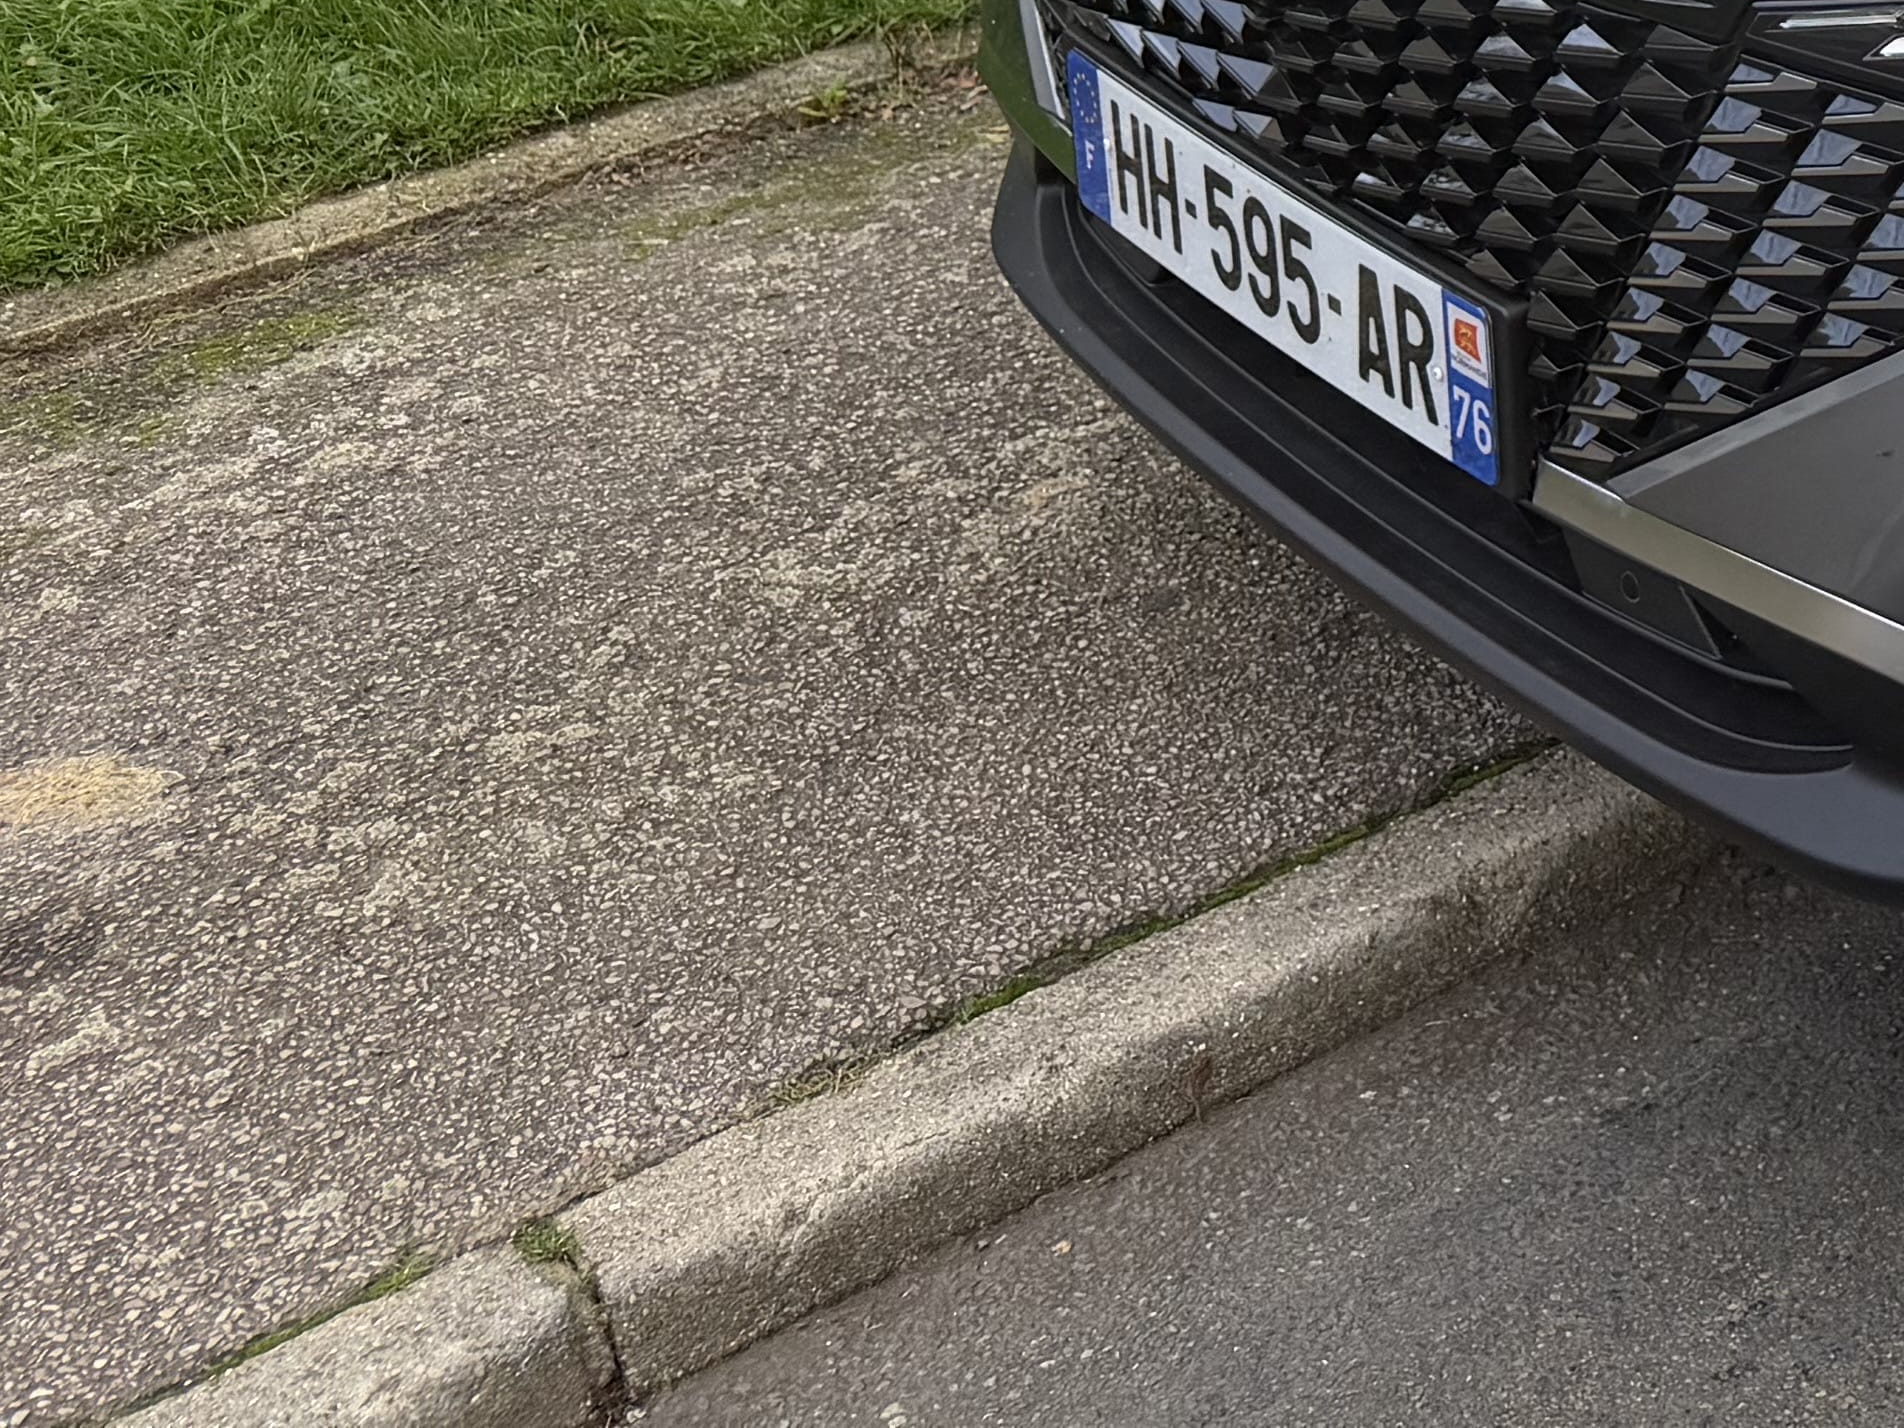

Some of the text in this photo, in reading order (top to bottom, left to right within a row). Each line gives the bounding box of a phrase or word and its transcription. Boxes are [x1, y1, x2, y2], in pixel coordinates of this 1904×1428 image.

[1085, 139, 1095, 170] F
[1111, 99, 1440, 427] HH-595-AR
[1453, 384, 1492, 455] 76
